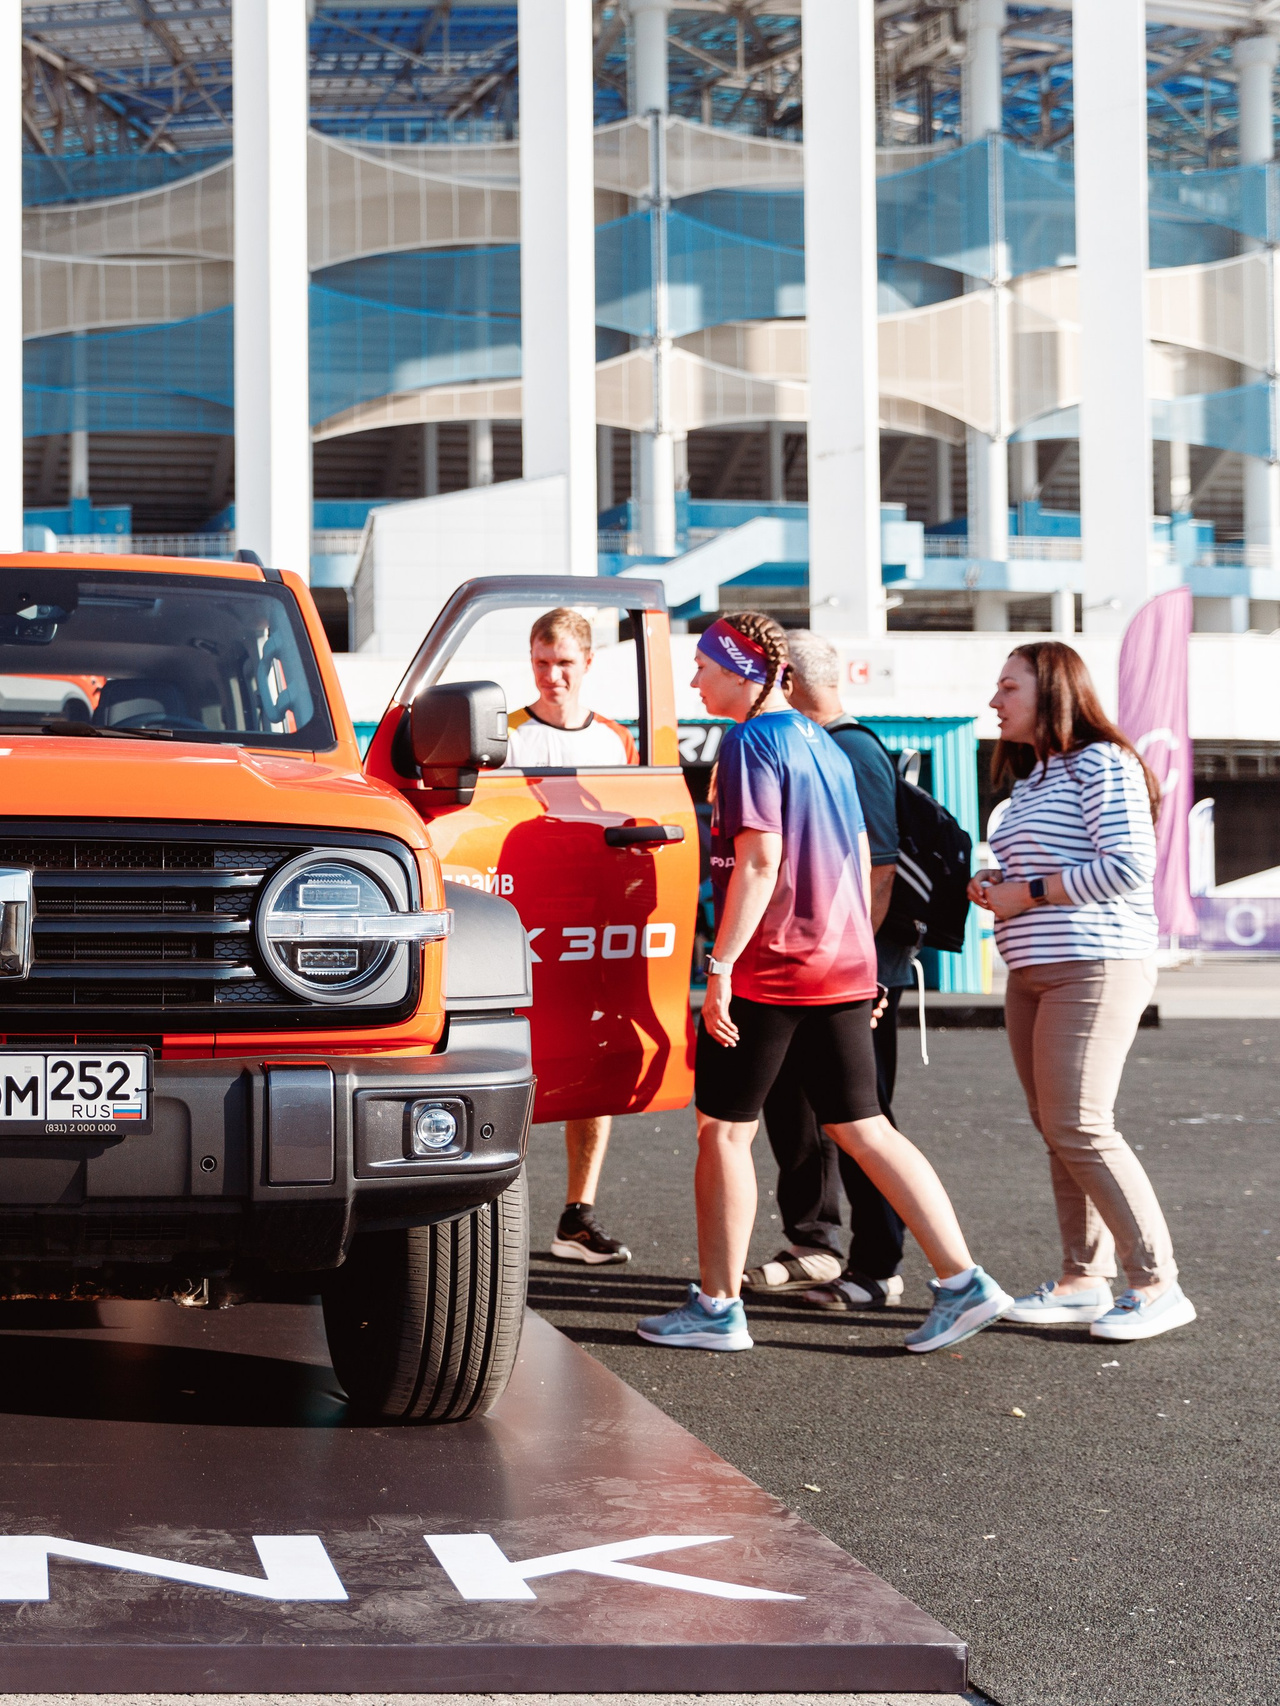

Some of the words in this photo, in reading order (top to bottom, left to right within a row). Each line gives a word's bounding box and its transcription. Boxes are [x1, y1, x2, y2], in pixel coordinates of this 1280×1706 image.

[558, 923, 677, 961] 300
[50, 1060, 131, 1101] 252
[72, 1104, 111, 1118] RUS
[45, 1123, 68, 1133] (831)
[69, 1123, 75, 1132] 2
[77, 1123, 96, 1132] 000
[98, 1123, 117, 1132] 000
